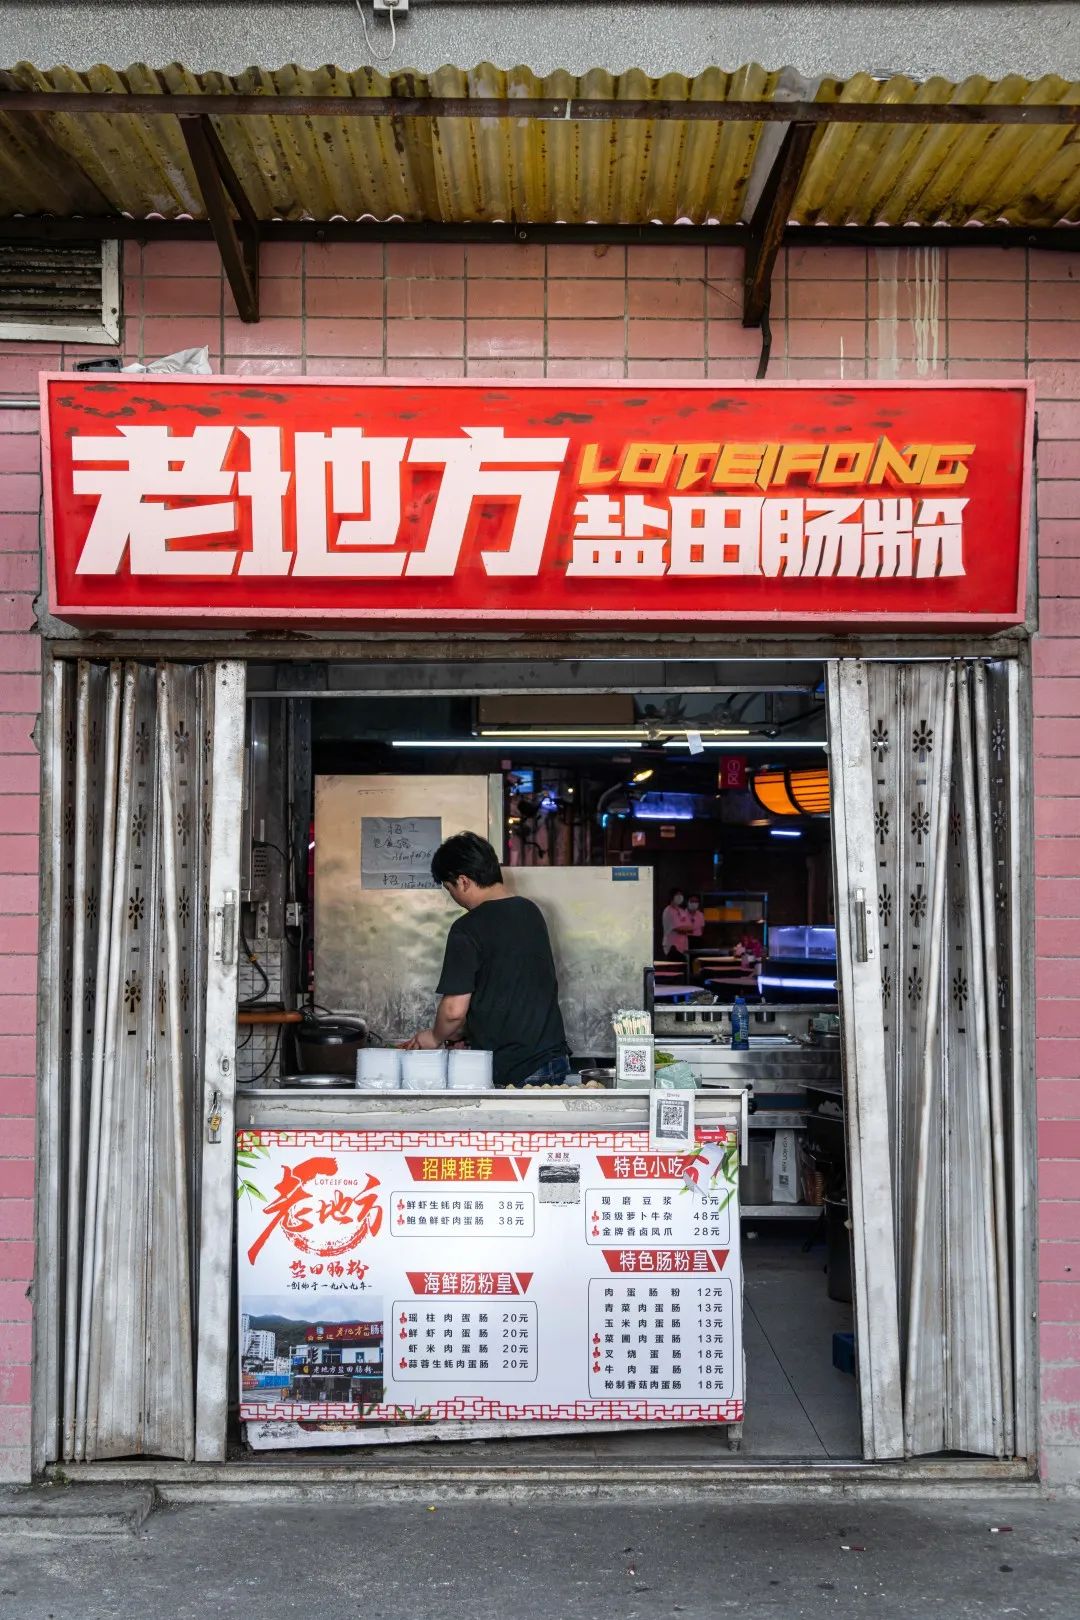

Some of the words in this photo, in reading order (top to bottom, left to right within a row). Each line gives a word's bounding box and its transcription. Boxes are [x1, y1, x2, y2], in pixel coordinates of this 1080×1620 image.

[579, 435, 976, 491] LOTEIFONG
[72, 426, 570, 577] 老地方
[565, 494, 970, 578] 盐田肠粉
[423, 1158, 493, 1181] 招牌推荐
[614, 1156, 685, 1179] 特色小吃
[314, 1179, 359, 1187] LOTEIFONG
[406, 1200, 484, 1210] 鲜虾生蚝肉蛋肠
[498, 1201, 525, 1210] 38元
[601, 1196, 672, 1206] 现磨豆浆
[701, 1196, 719, 1206] 5元
[248, 1157, 383, 1266] 老地方
[601, 1211, 673, 1221] 顶级萝卜牛杂
[693, 1211, 720, 1221] 48元
[406, 1215, 484, 1225] 鲍鱼鲜虾肉蛋肠
[498, 1216, 525, 1226] 38元
[693, 1227, 720, 1236] 28元
[620, 1250, 709, 1272] 特色肠粉皇
[289, 1260, 370, 1281] 盐田肠粉
[424, 1272, 513, 1294] 海鲜肠粉皇
[604, 1287, 680, 1297] 肉蛋肠粉
[697, 1288, 723, 1297] 12元
[604, 1302, 681, 1313] 青菜肉蛋肠
[697, 1303, 723, 1313] 13元
[408, 1313, 489, 1323] 瑶柱肉蛋肠
[502, 1313, 529, 1323] 20元
[604, 1318, 681, 1328] 玉米肉蛋肠
[697, 1318, 723, 1328] 13元
[408, 1328, 489, 1338] 鲜虾肉蛋肠
[502, 1328, 529, 1338] 20元
[698, 1334, 724, 1344] 13元
[408, 1343, 489, 1354] 虾米肉蛋肠
[502, 1344, 529, 1354] 20元
[604, 1349, 682, 1359] 叉烧蛋肠
[697, 1349, 724, 1359] 18元
[408, 1358, 489, 1369] 蒜蓉生蚝肉蛋肠
[502, 1359, 529, 1369] 20元
[604, 1364, 682, 1375] 牛肉蛋肠
[698, 1364, 724, 1375] 18元
[604, 1379, 682, 1390] 秘制香菇肉蛋肠
[698, 1380, 724, 1390] 18元
